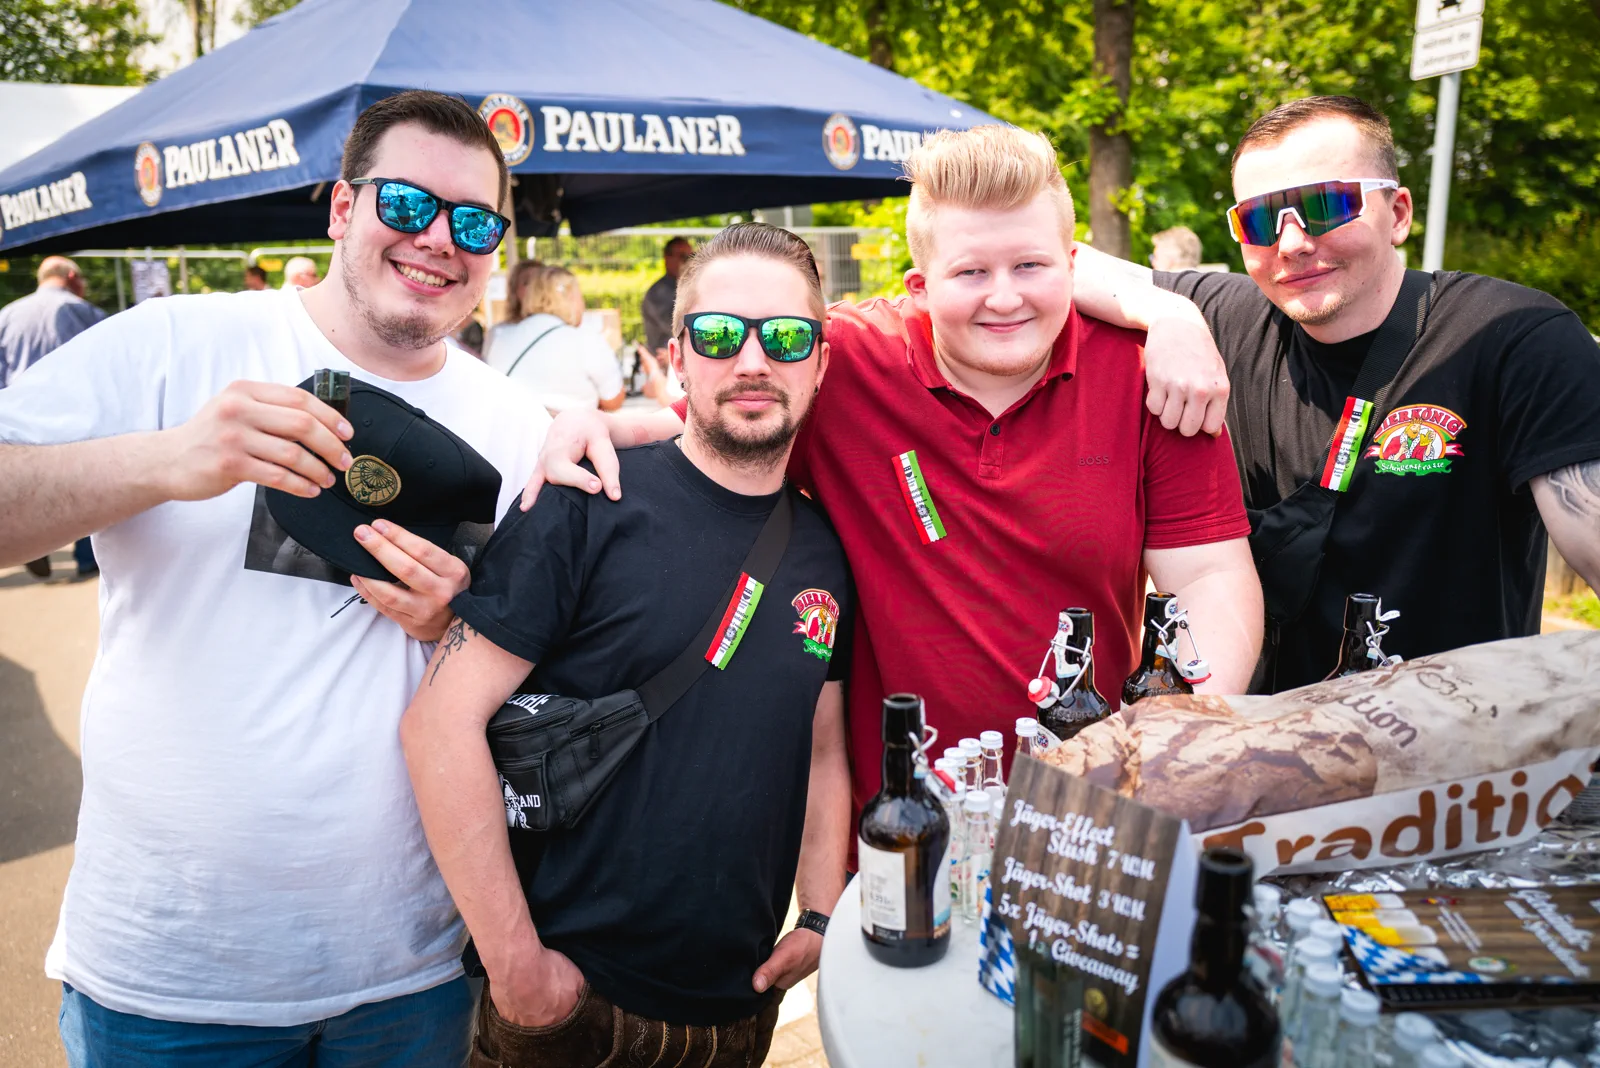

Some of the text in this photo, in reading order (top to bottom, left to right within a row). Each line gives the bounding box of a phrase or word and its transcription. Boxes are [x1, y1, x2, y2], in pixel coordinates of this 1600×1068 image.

[163, 118, 300, 189] PAULANER
[540, 105, 746, 157] PAULANER
[0, 171, 93, 230] PAULANER
[1078, 455, 1110, 467] BOSS
[1010, 799, 1115, 847] Jäger-Effect
[1203, 768, 1594, 866] Traditio
[1047, 831, 1098, 866] Slush
[1107, 849, 1120, 870] 7
[1001, 856, 1092, 904] Jäger-Shot
[1097, 889, 1111, 909] 3
[998, 893, 1021, 919] 5x
[1023, 901, 1123, 956] Jäger-Shots
[1051, 938, 1139, 995] Giveaway
